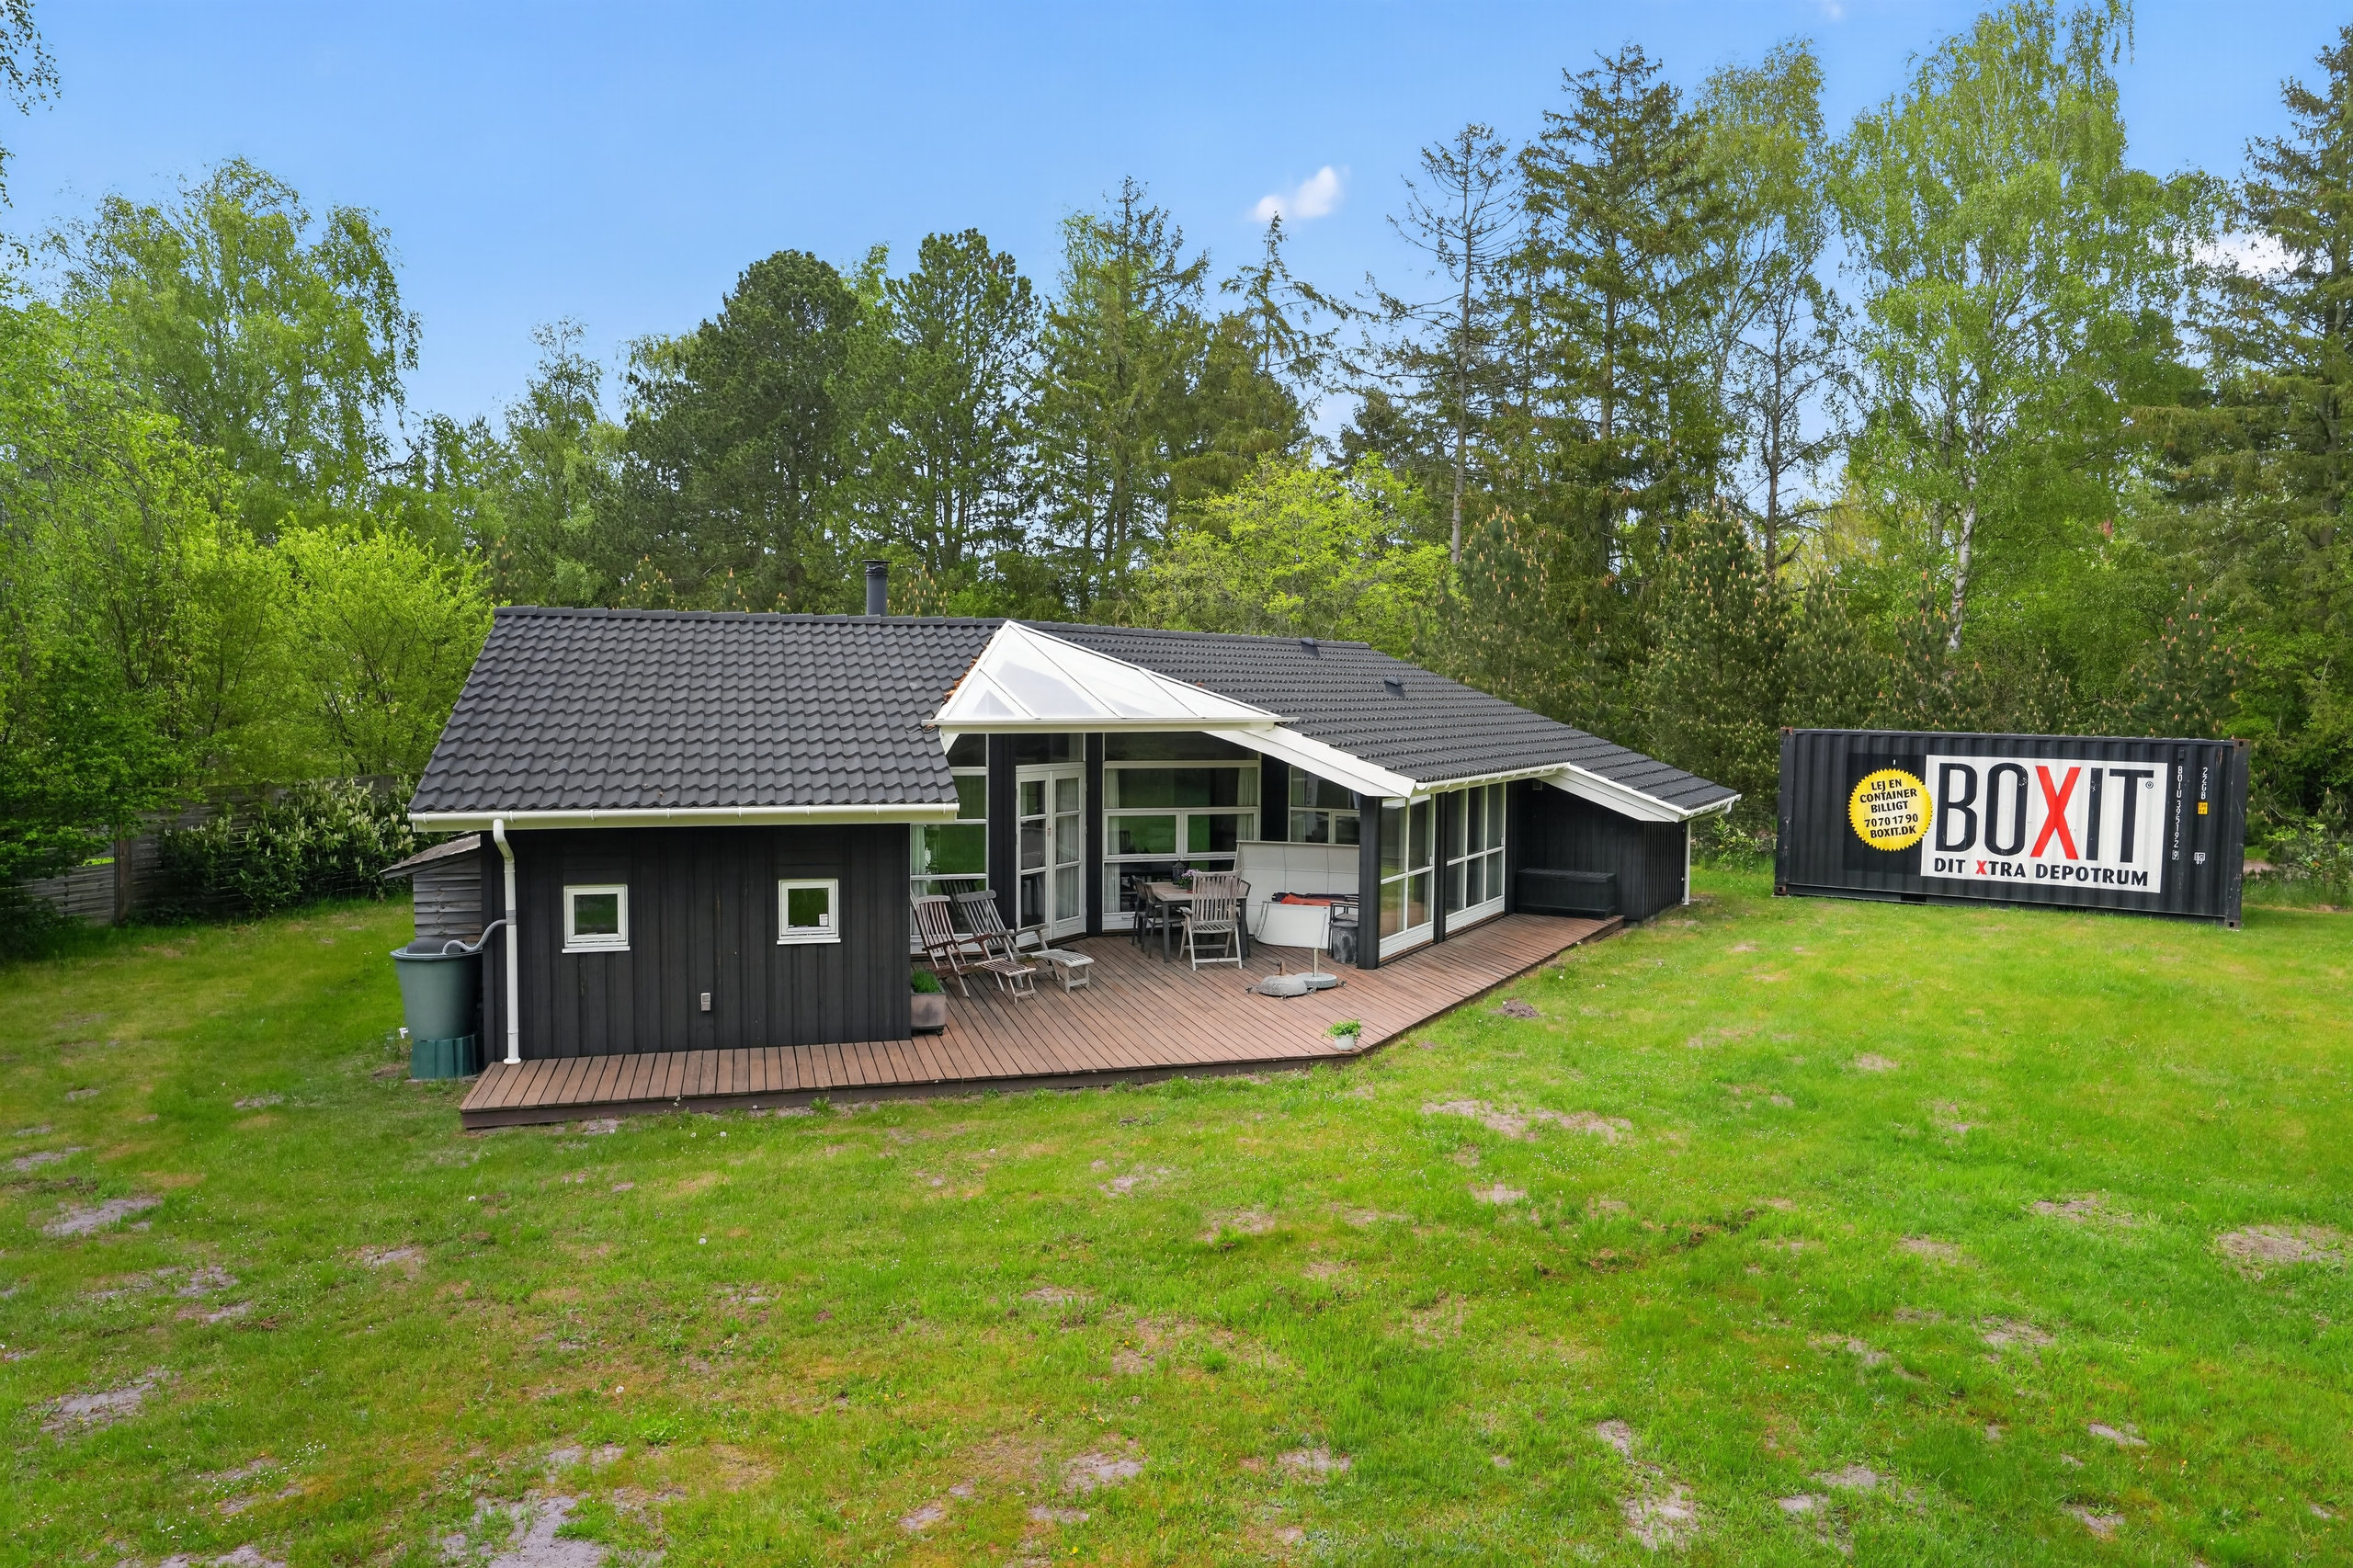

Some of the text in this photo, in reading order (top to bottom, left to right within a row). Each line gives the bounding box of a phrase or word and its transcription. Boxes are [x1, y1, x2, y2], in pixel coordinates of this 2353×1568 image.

[1871, 779, 1902, 791] LEJ EN
[1860, 789, 1917, 803] CONTAINER
[1871, 801, 1908, 813] BILLIGT
[1935, 762, 2154, 862] BOXIT
[1870, 825, 1916, 838] BOXIT.DK
[2173, 801, 2181, 848] 395192
[1934, 858, 2149, 886] DIT XTRA DEPOTRUM
